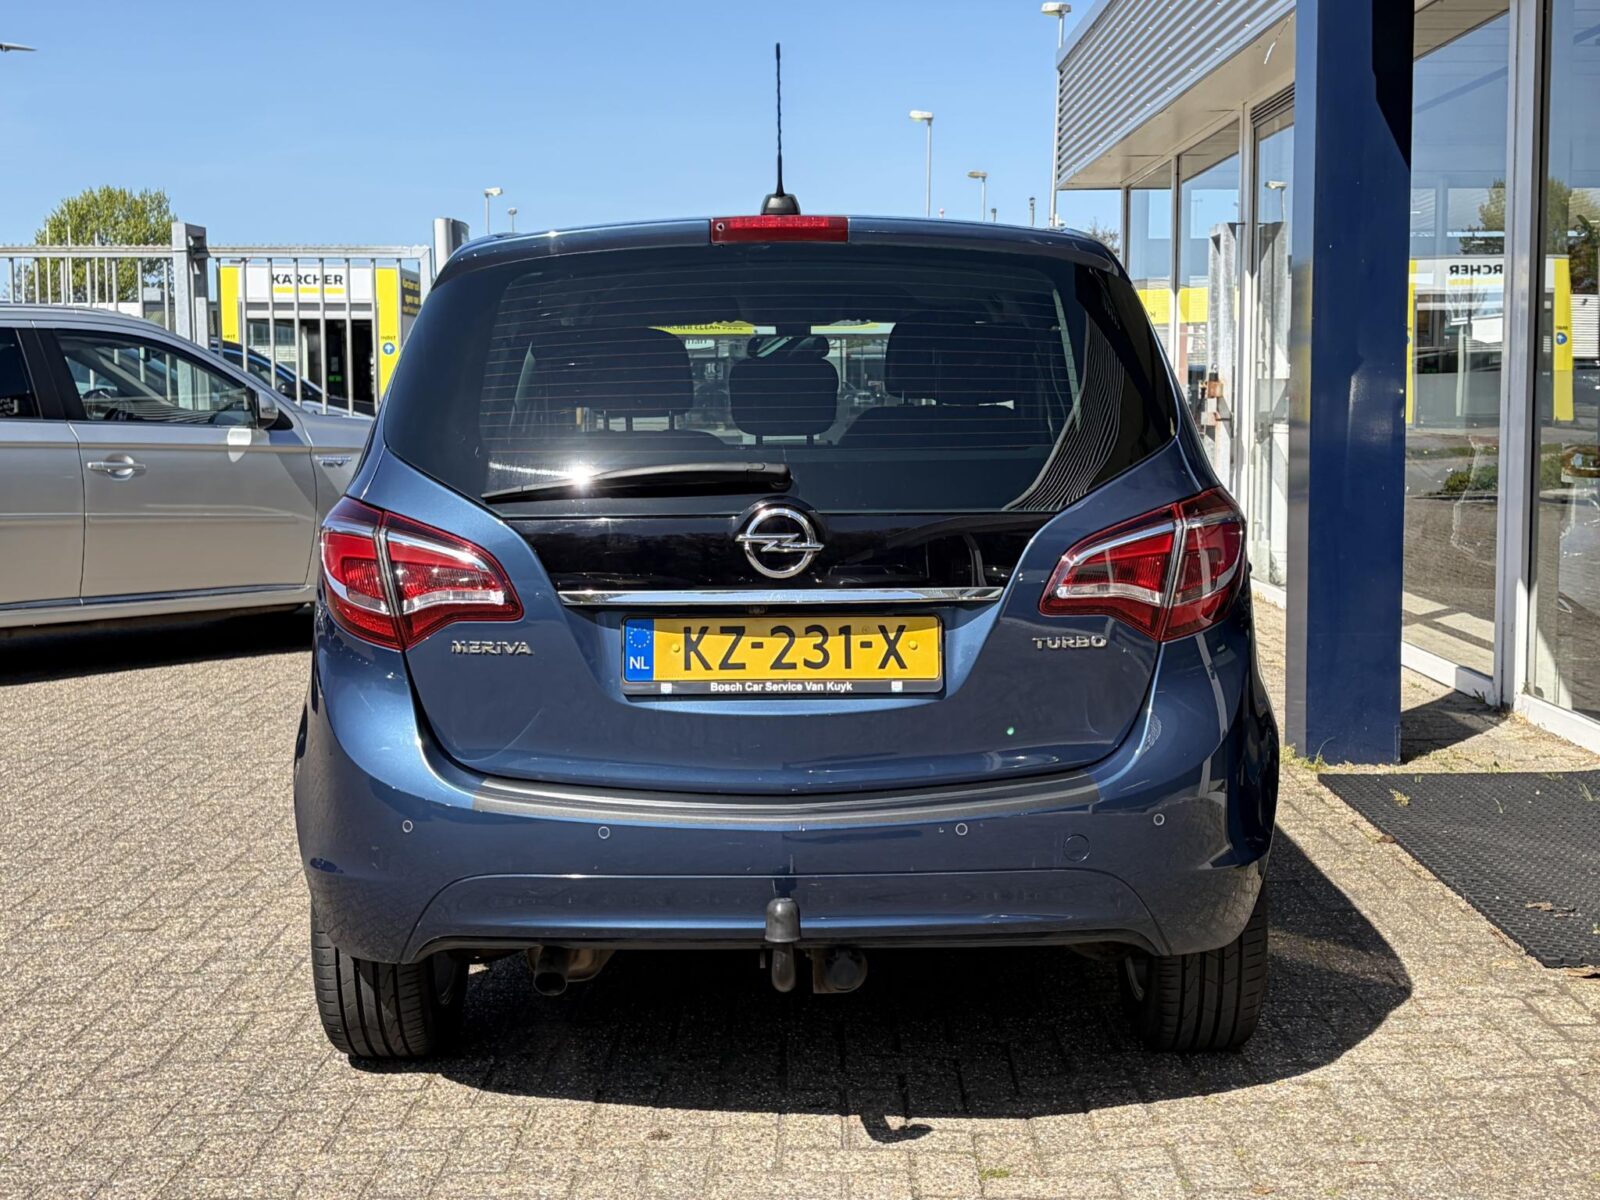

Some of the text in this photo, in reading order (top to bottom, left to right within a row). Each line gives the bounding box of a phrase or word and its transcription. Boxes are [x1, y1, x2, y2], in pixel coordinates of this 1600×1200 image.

[451, 640, 533, 655] MERIVA
[683, 625, 908, 671] KZ-231-X
[1032, 635, 1107, 649] TURBO
[629, 656, 650, 670] NL
[710, 681, 853, 693] Bosch Car Service Van Kuyk
